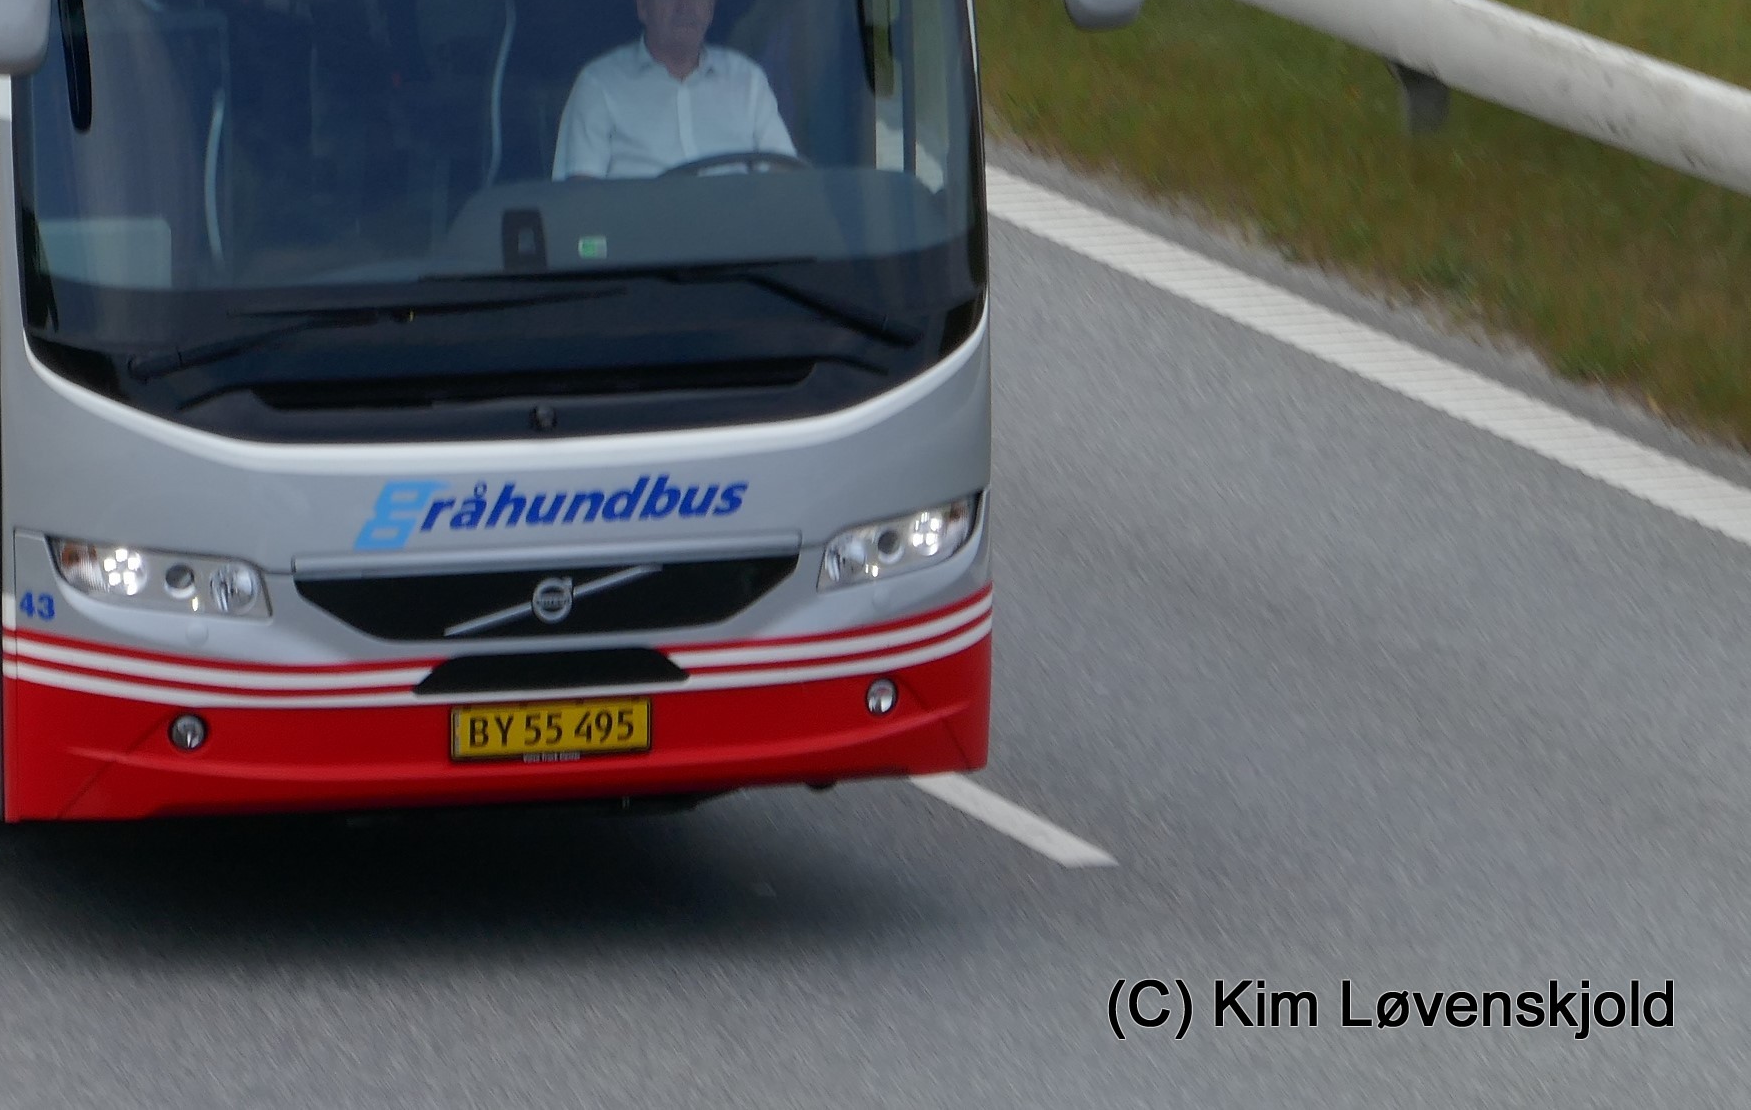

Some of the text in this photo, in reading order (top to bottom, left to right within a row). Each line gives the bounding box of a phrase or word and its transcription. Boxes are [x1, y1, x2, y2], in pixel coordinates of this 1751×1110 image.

[19, 590, 56, 620] 43
[469, 709, 634, 748] BY 55 495
